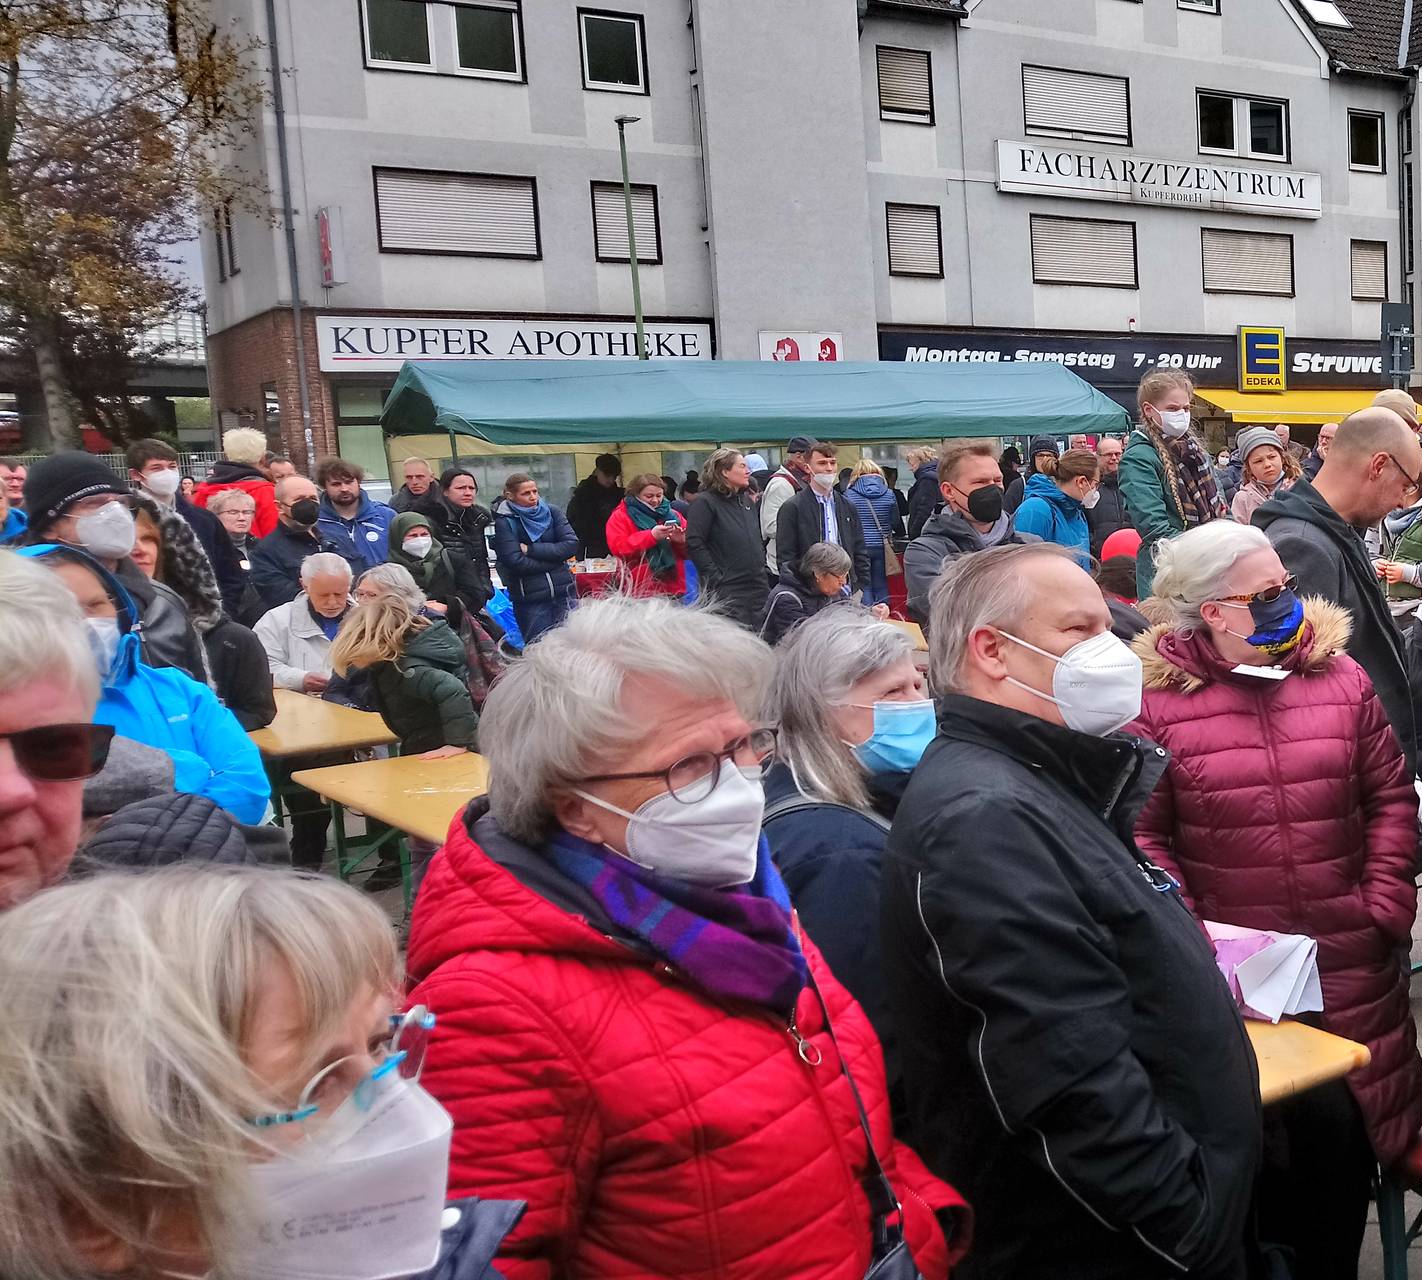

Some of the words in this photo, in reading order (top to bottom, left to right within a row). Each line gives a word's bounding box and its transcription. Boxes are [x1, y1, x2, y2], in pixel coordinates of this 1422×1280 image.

[1019, 149, 1305, 199] FACHARZTZENTRUM
[331, 327, 494, 355] KUPFER
[506, 329, 700, 357] APOTHEKE
[1014, 349, 1116, 369] Samstag
[1186, 354, 1222, 369] Uhr
[1246, 377, 1282, 386] EDEKA
